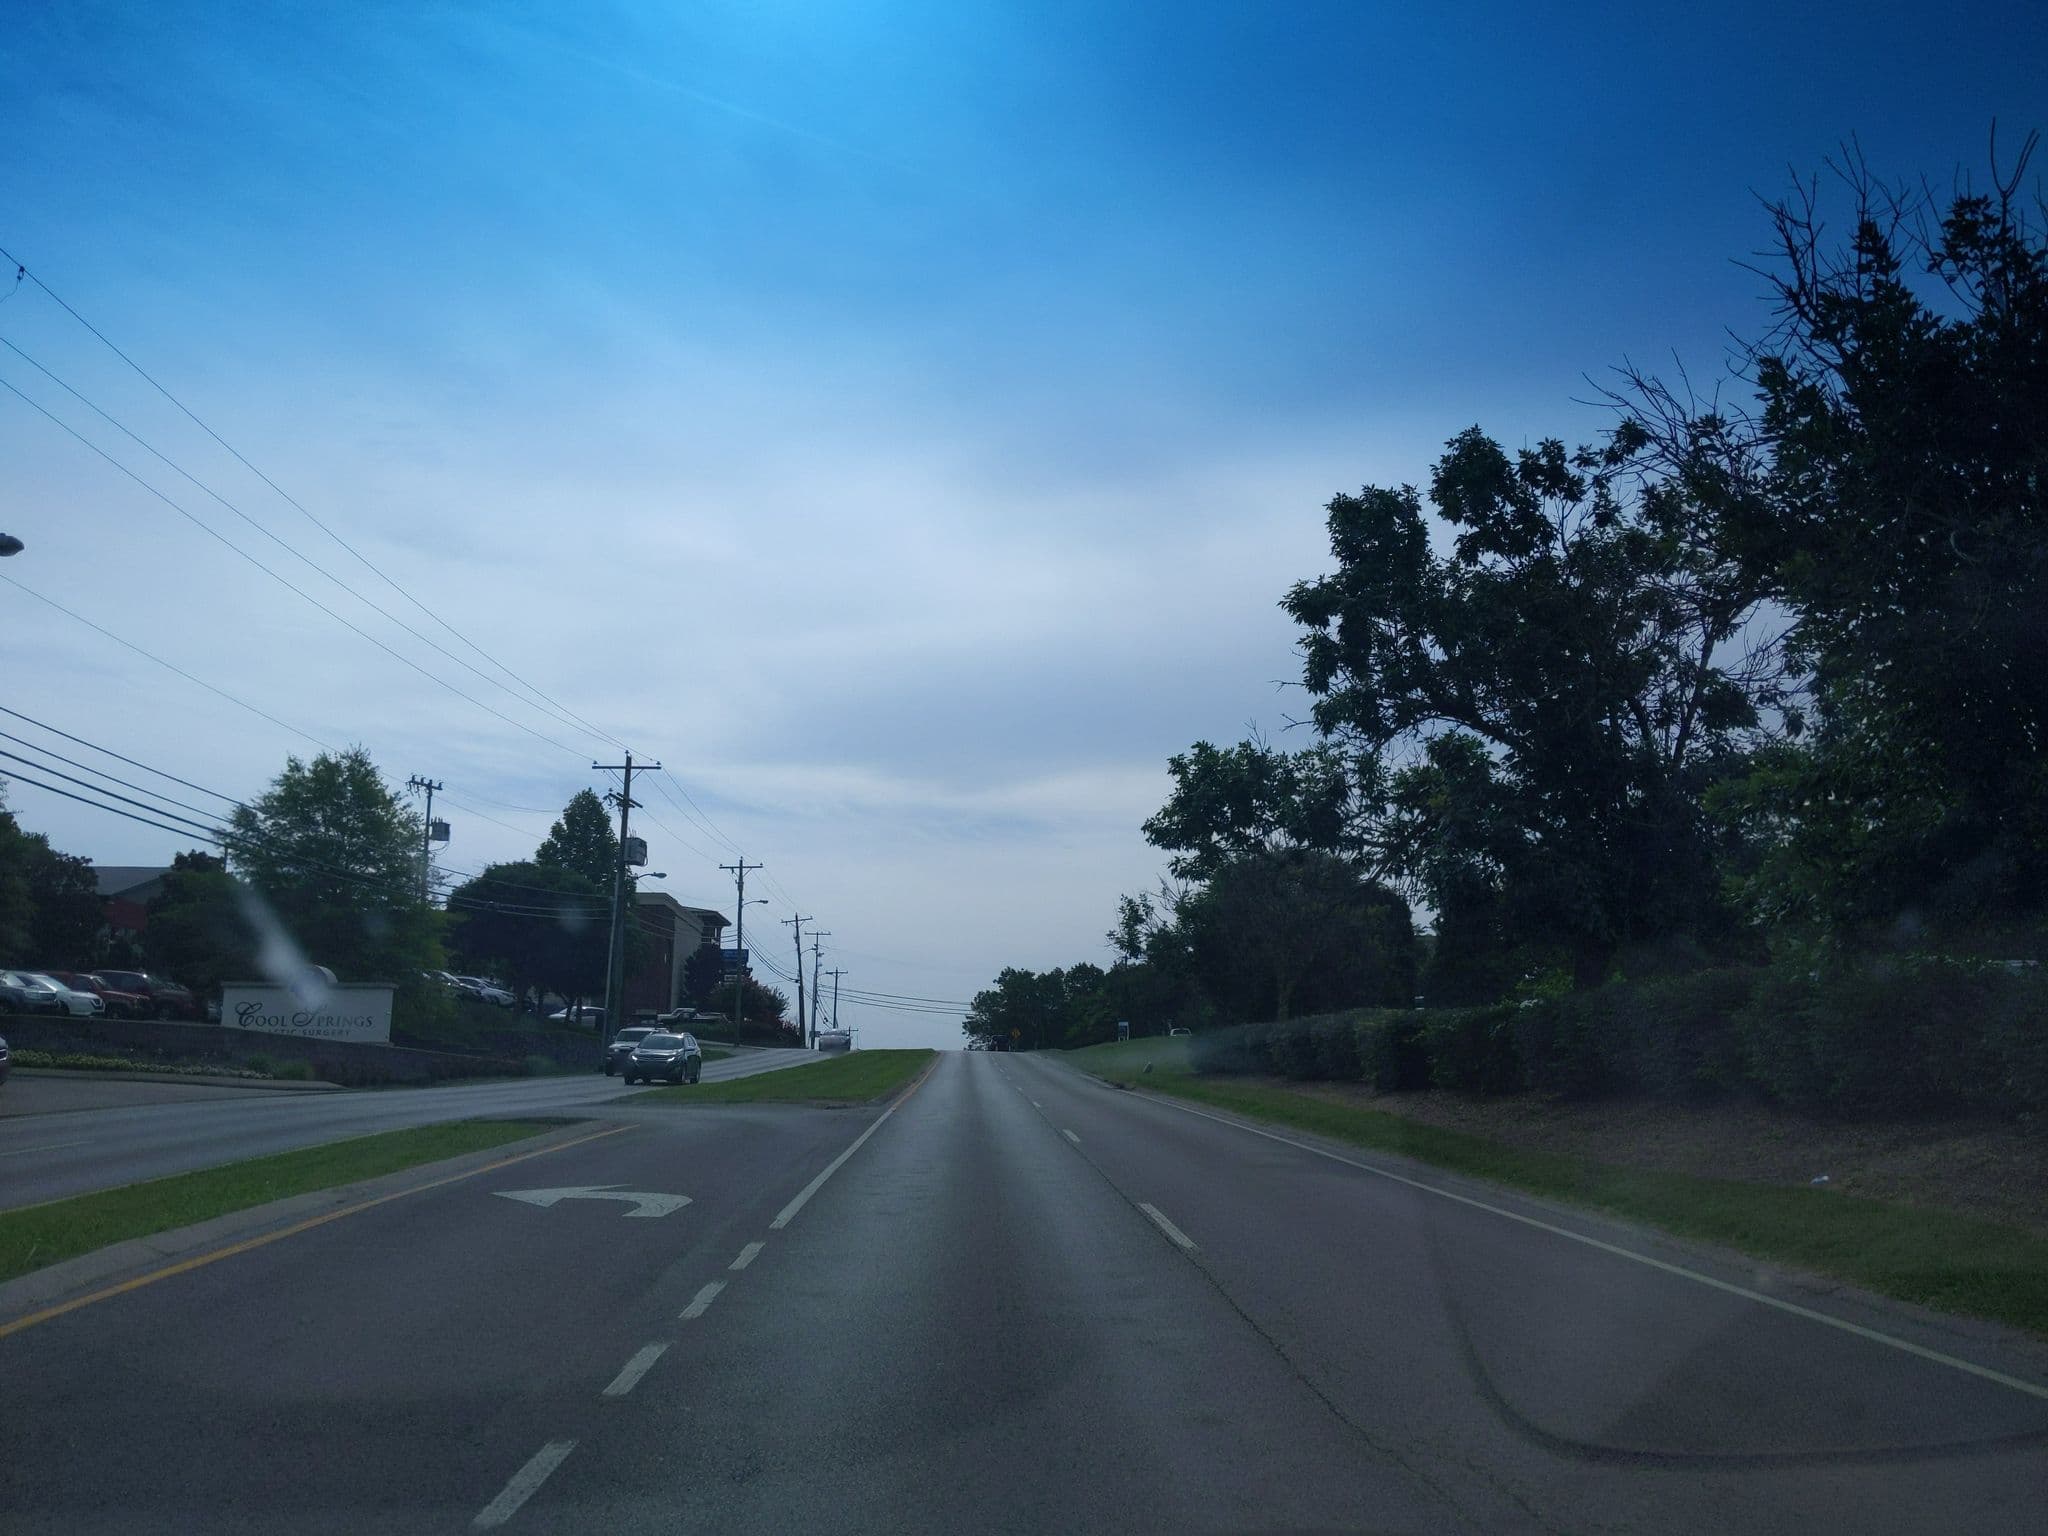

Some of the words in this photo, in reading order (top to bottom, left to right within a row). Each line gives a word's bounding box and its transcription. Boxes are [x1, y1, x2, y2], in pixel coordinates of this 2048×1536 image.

[235, 1001, 287, 1027] COOL
[292, 1004, 374, 1027] SPRINGS
[303, 1028, 350, 1037] SURGERY
